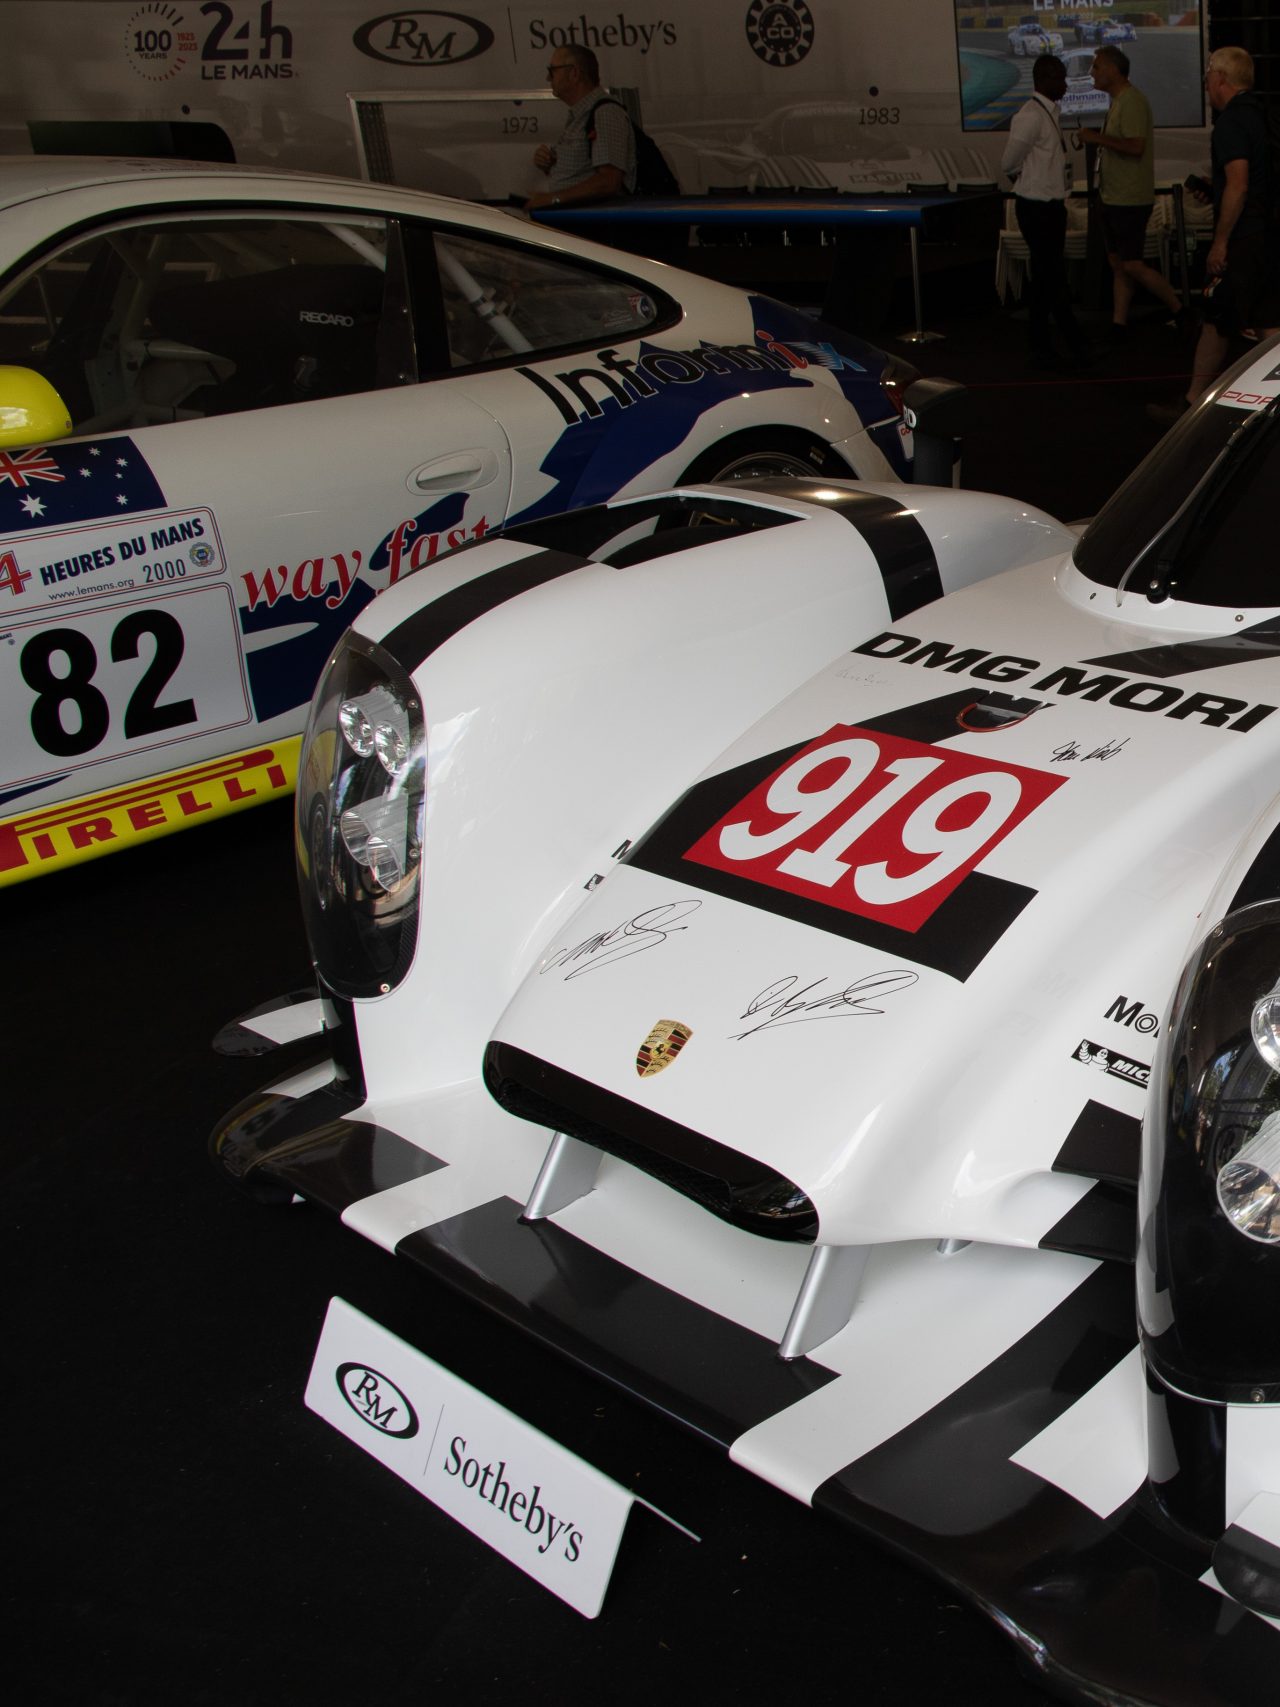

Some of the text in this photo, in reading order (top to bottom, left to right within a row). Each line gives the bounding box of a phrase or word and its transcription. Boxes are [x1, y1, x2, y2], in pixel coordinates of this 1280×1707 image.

[134, 30, 171, 52] 100
[529, 14, 677, 53] Sotheby's
[201, 64, 293, 80] LE MANS
[858, 107, 900, 125] 1983
[1063, 93, 1106, 102] othmans
[502, 117, 539, 134] 1973
[299, 310, 354, 327] RECARO
[514, 329, 868, 426] Informix
[40, 546, 116, 586] HEURES
[118, 536, 147, 561] DU
[150, 518, 205, 550] MANS
[48, 558, 186, 601] www.lemans.org 2000
[240, 550, 362, 611] way
[20, 609, 197, 758] 82
[850, 631, 1280, 734] DMG MORI
[718, 738, 1023, 905] 919
[1103, 994, 1161, 1039] Mo
[444, 1435, 583, 1562] Sotheby's
